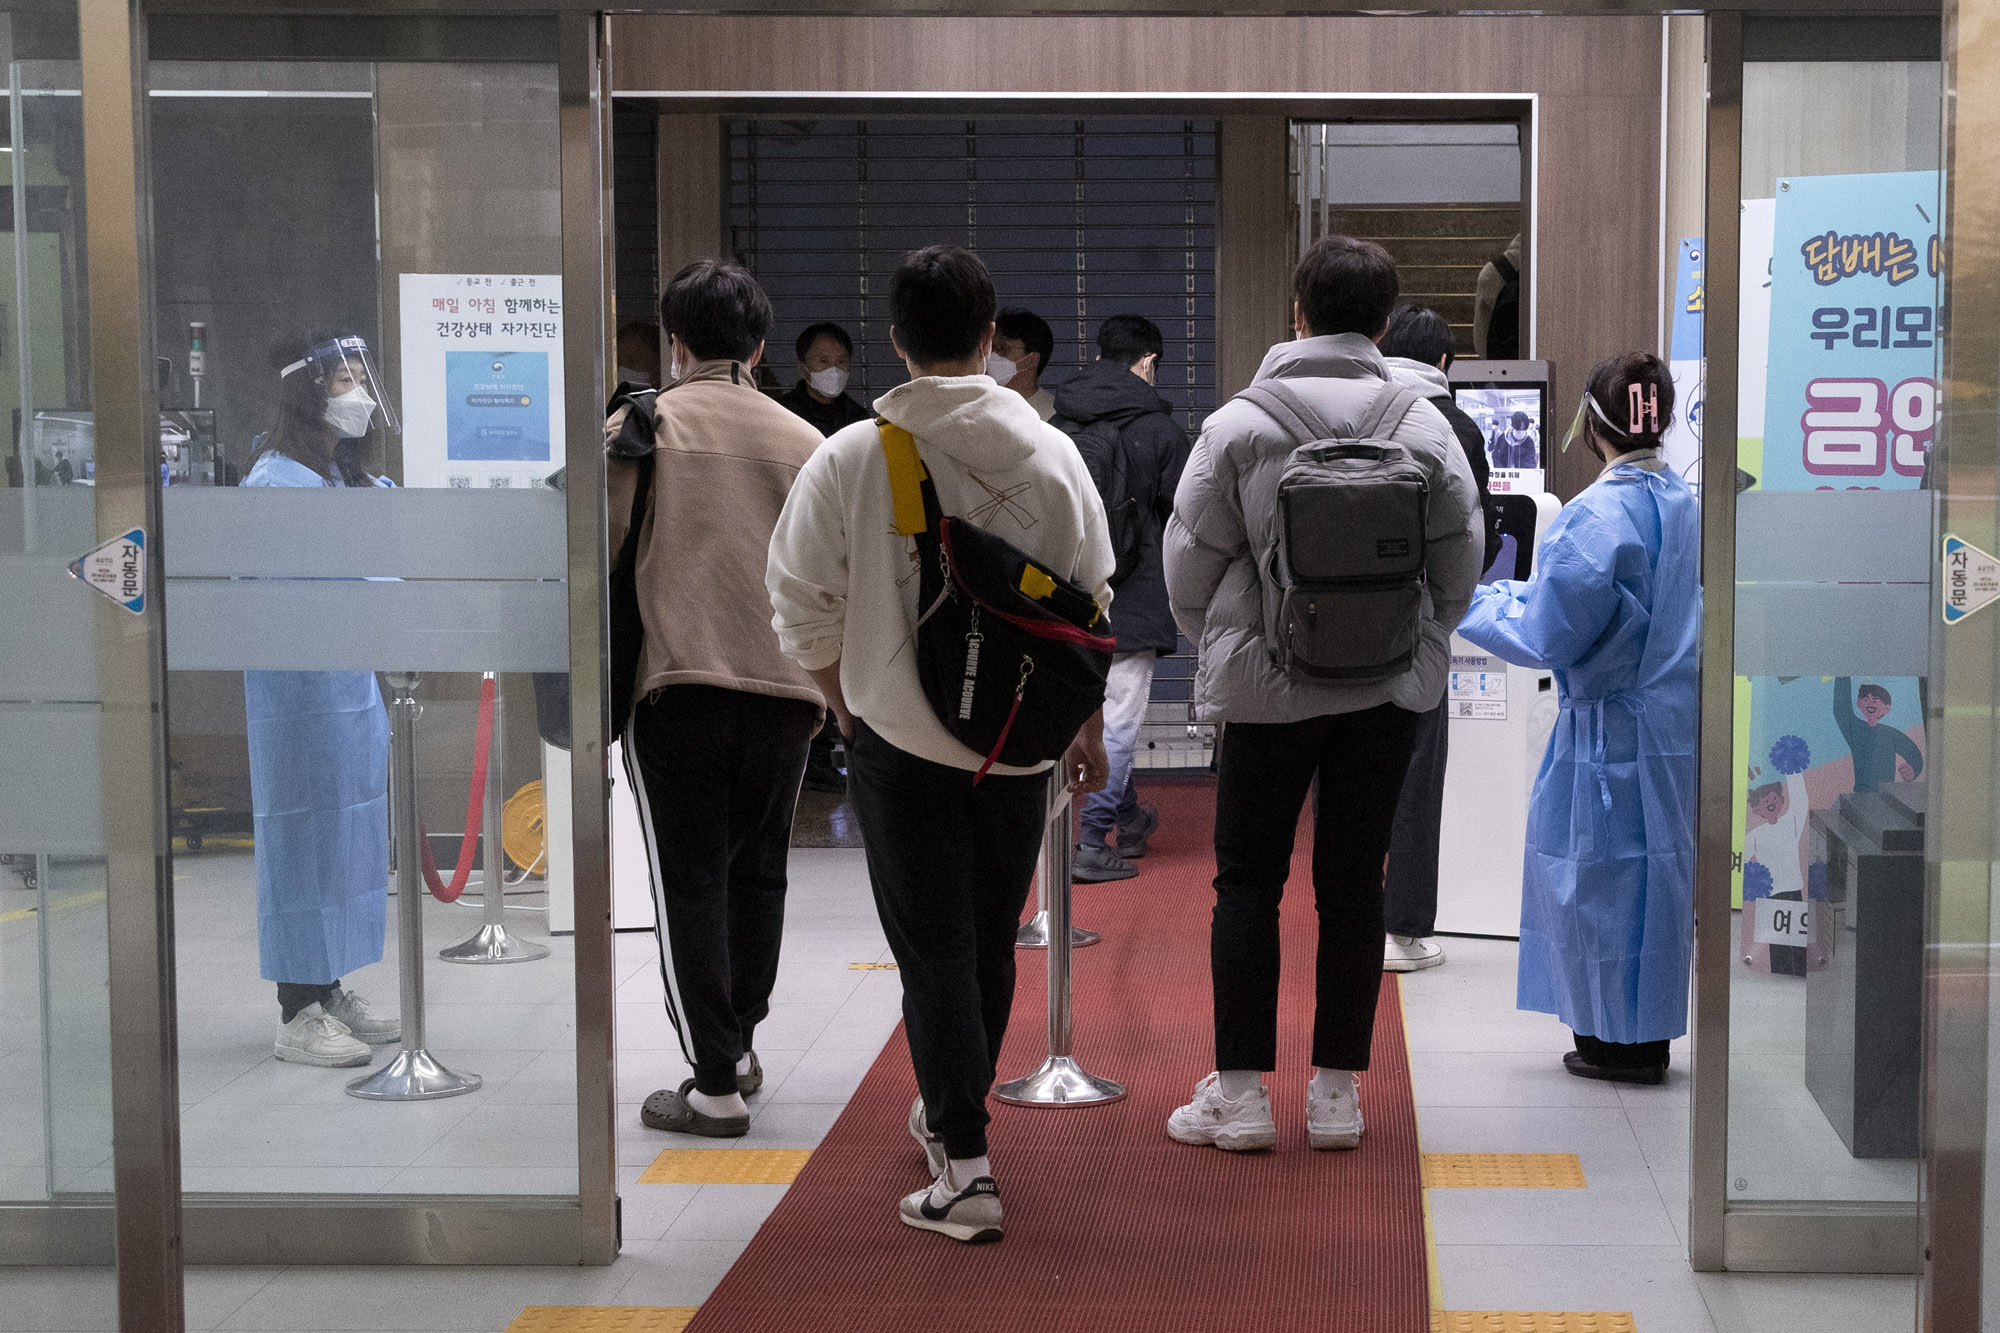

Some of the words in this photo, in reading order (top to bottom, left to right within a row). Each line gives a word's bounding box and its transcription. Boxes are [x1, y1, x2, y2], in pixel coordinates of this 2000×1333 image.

[1802, 231, 1918, 285] 담배는
[466, 278, 481, 286] 등교
[484, 278, 492, 286] 전
[510, 278, 525, 287] 출근
[528, 278, 536, 286] 전
[432, 298, 460, 314] 매일
[469, 298, 495, 314] 아침
[504, 298, 561, 314] 함께하는
[437, 322, 492, 338] 건강상태
[501, 322, 557, 338] 자가진단
[122, 544, 138, 597] 자동문
[1951, 551, 1968, 606] 자동문
[1465, 656, 1487, 665] 사용방법
[976, 1182, 995, 1191] NIKE
